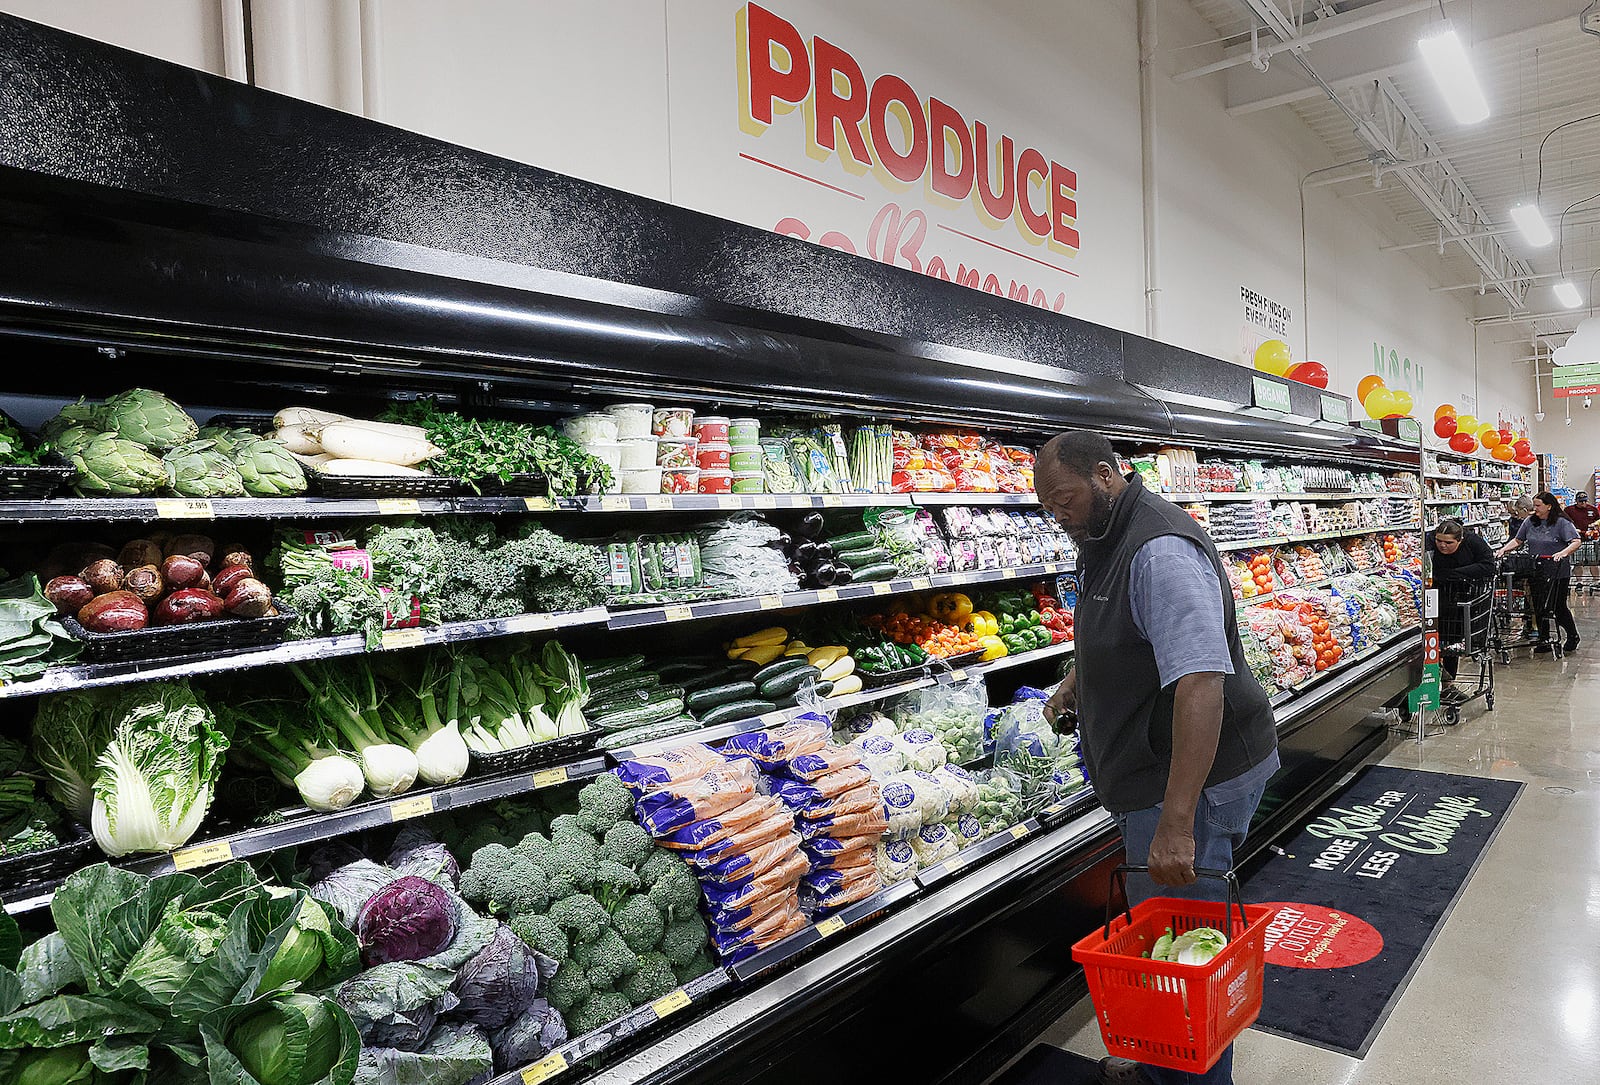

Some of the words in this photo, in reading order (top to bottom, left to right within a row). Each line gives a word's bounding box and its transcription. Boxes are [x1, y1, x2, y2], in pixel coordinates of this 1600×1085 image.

[737, 1, 1080, 256] PRODUCE
[1240, 286, 1263, 309] FRESH
[1282, 307, 1292, 322] ON
[1245, 306, 1267, 328] EVERY
[1257, 382, 1288, 408] ORGANIC
[1373, 790, 1408, 808] FOR
[1305, 805, 1386, 840] Kale
[1308, 838, 1360, 871] MORE
[1355, 850, 1401, 879] LESS
[1263, 906, 1305, 952] ROCERY
[1278, 917, 1326, 952] OUTLET
